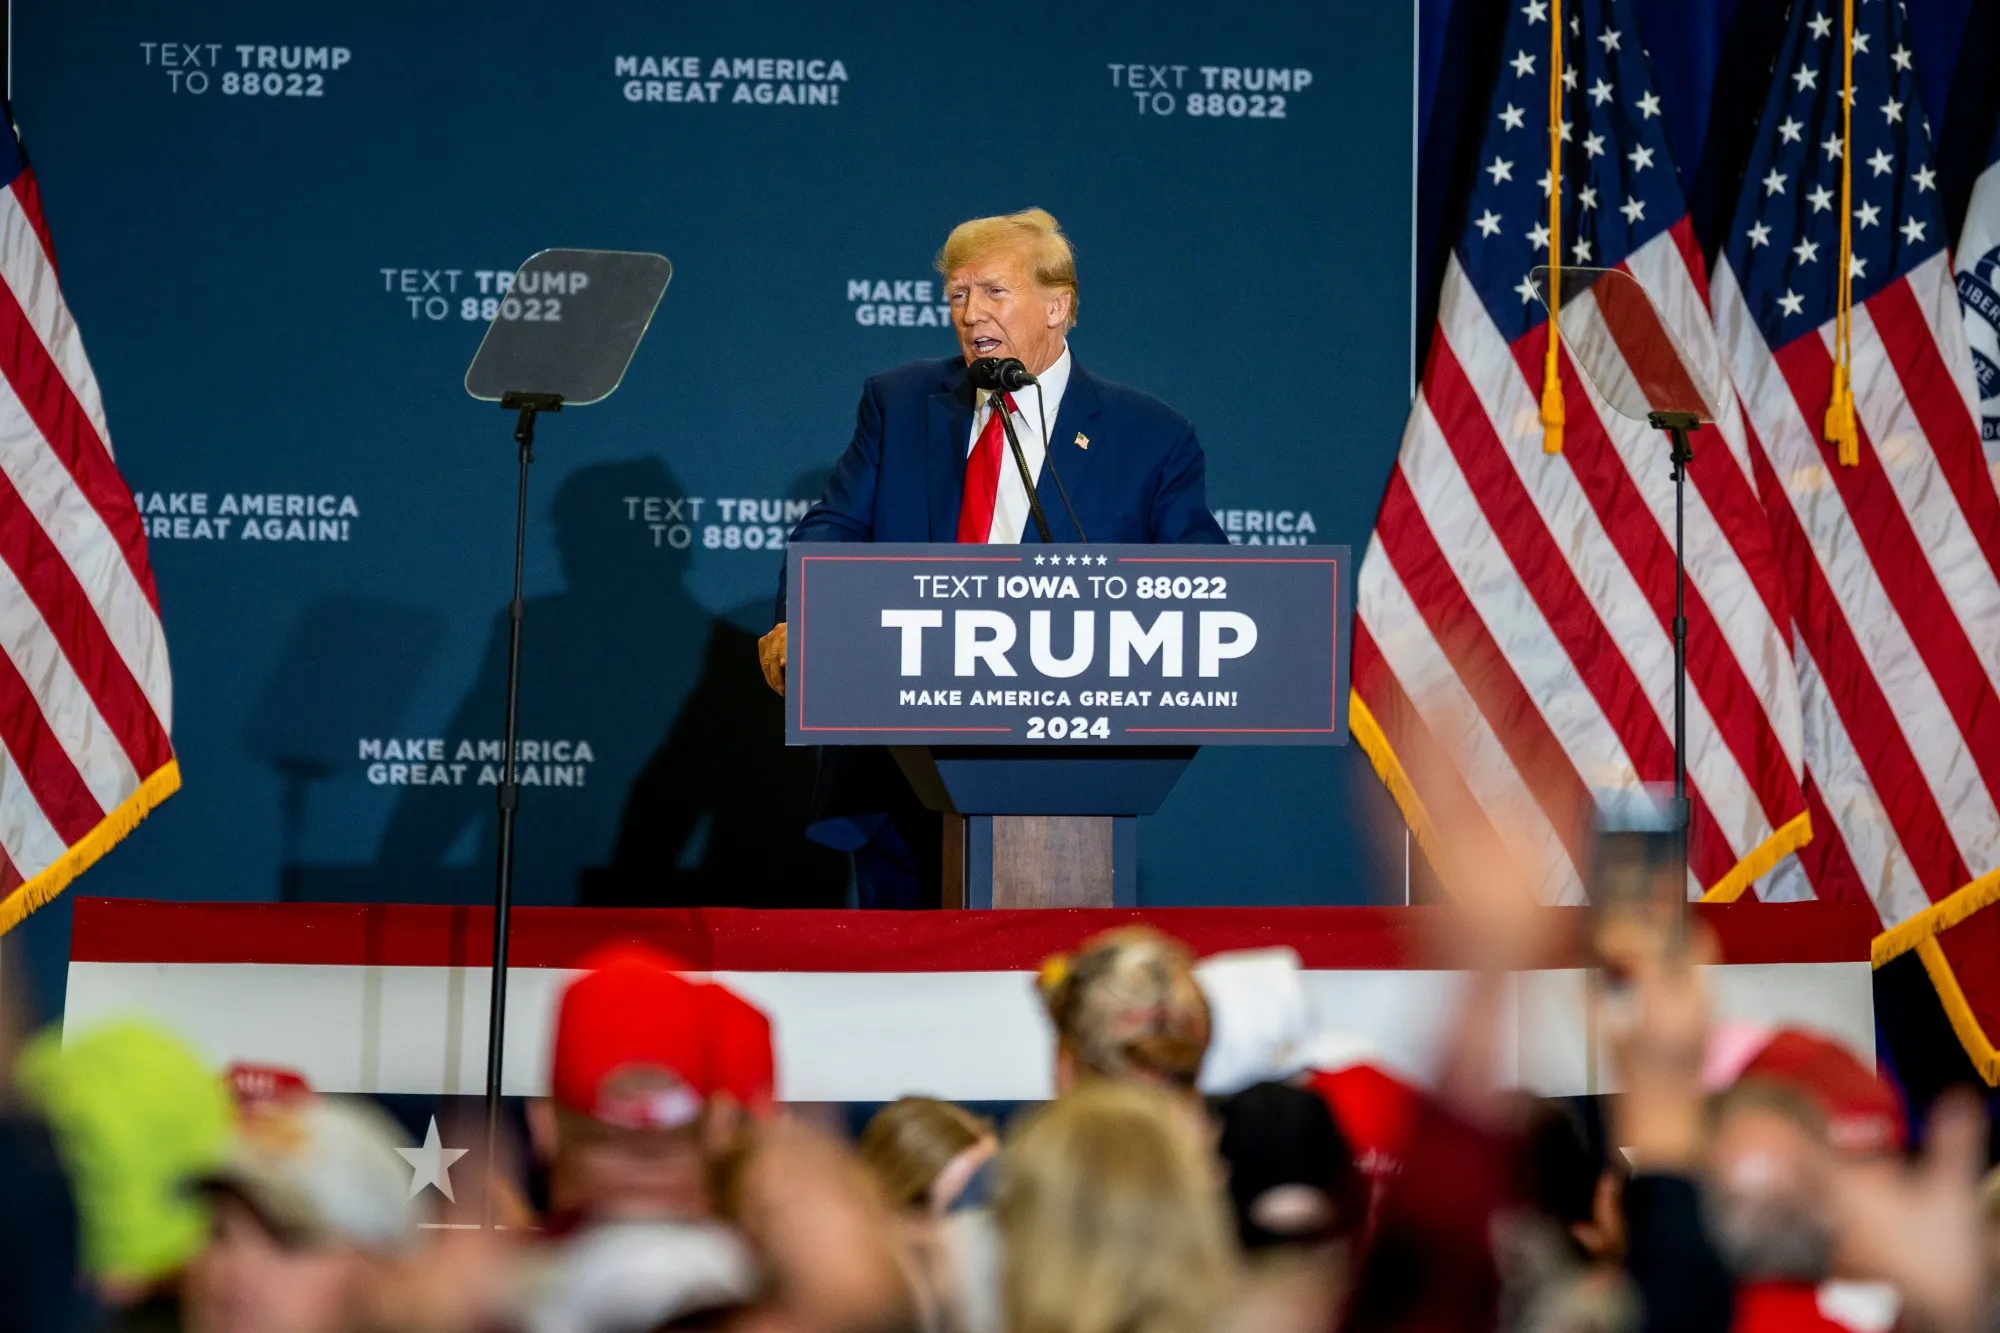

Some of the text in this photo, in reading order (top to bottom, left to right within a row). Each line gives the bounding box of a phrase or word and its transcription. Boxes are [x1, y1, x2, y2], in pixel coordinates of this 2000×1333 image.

[140, 42, 351, 70] TEXT TRUMP
[615, 55, 848, 82] MAKE AMERICA
[166, 70, 324, 97] TO 88022
[1107, 63, 1313, 92] TEXT TRUMP
[623, 79, 839, 106] GREAT AGAIN!
[1132, 90, 1286, 119] TO 88022
[379, 268, 589, 295] TEXT TRUMP
[847, 279, 933, 303] MAKE
[405, 295, 562, 322] TO 88022
[855, 303, 951, 327] GREAT
[1957, 277, 2000, 327] LIBER
[218, 493, 360, 518] AMERICA
[623, 496, 821, 524] TEXT TRUM
[241, 518, 350, 542] AGAIN!
[1212, 509, 1318, 534] ERICA
[648, 523, 793, 550] TO 8802
[913, 574, 1227, 600] TEXT IOWA TO 88022
[881, 609, 1258, 679] TRUMP
[899, 690, 1239, 707] MAKE AMERICA GREAT AGAIN!
[1026, 716, 1111, 740] 2024
[358, 738, 595, 763] MAKE AMRICA
[366, 762, 468, 786] GREAT
